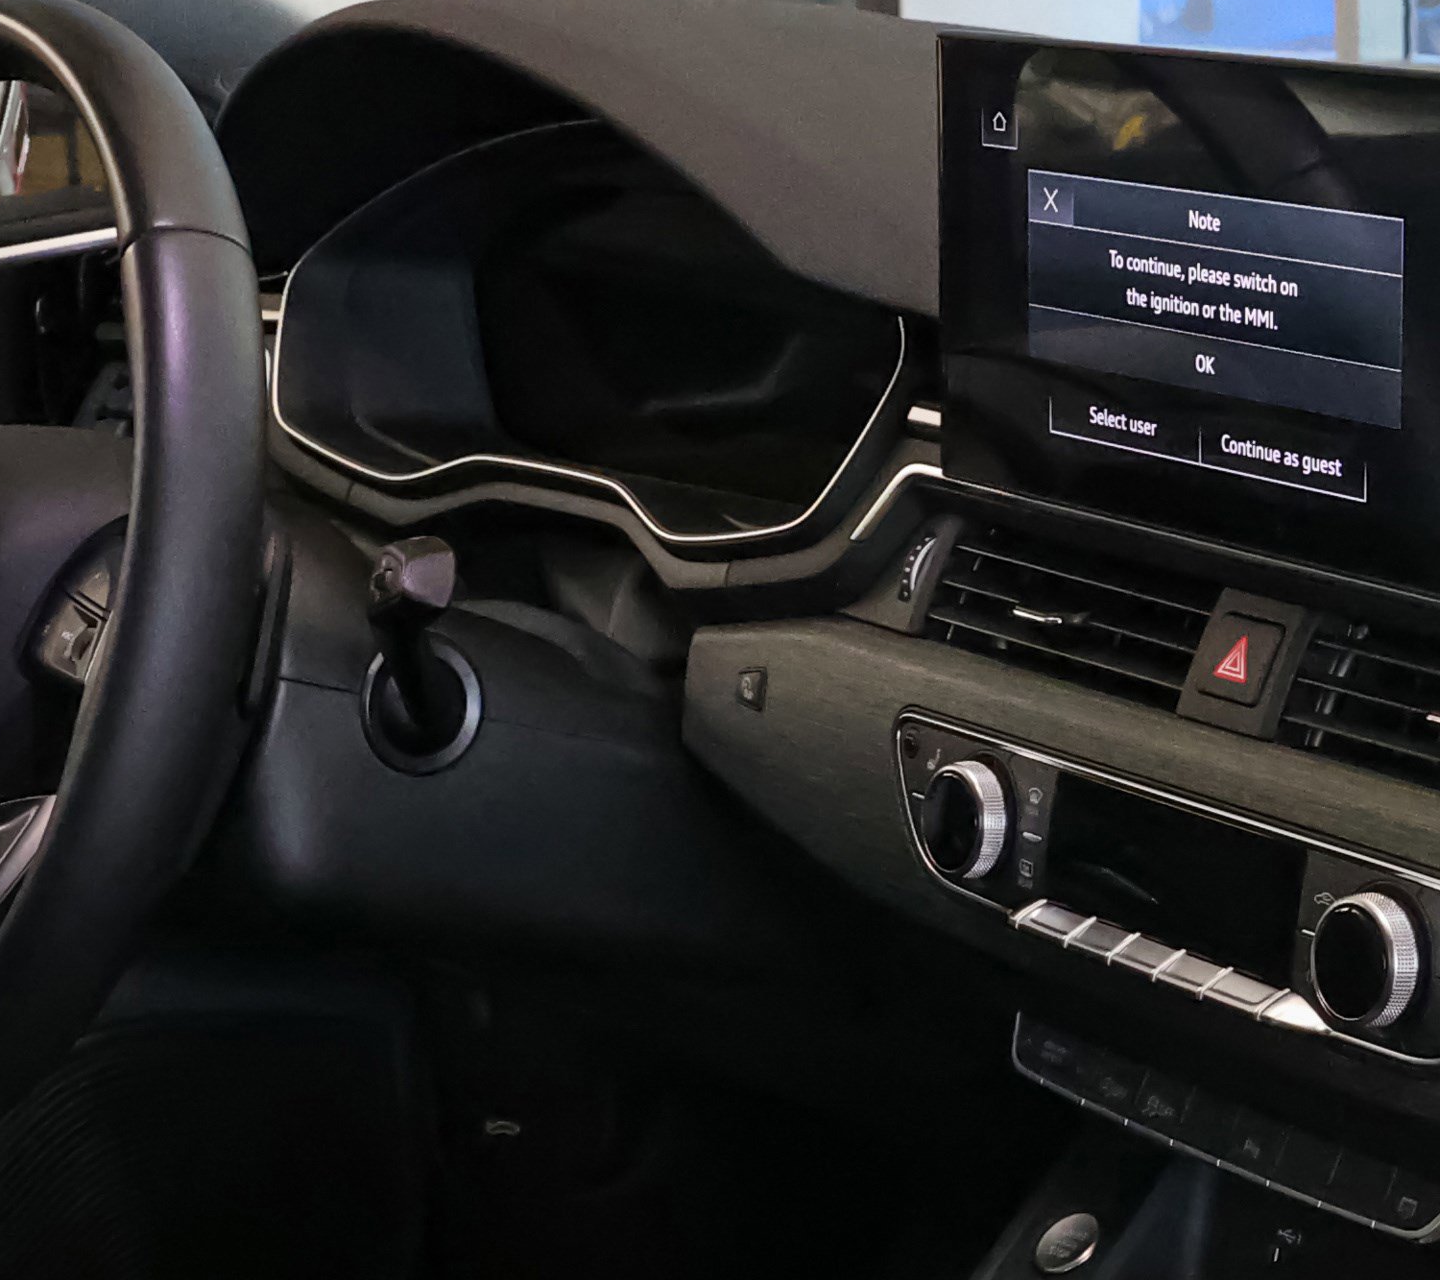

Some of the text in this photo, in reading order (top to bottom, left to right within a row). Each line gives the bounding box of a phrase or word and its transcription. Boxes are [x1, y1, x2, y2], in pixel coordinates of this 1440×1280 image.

[1188, 209, 1221, 232] Note
[1108, 249, 1298, 297] To continue, please switch on
[1126, 287, 1278, 330] the ignition or the MMI.
[1195, 354, 1215, 375] OK
[1089, 406, 1158, 437] Select user
[1221, 434, 1342, 477] Continue as guest
